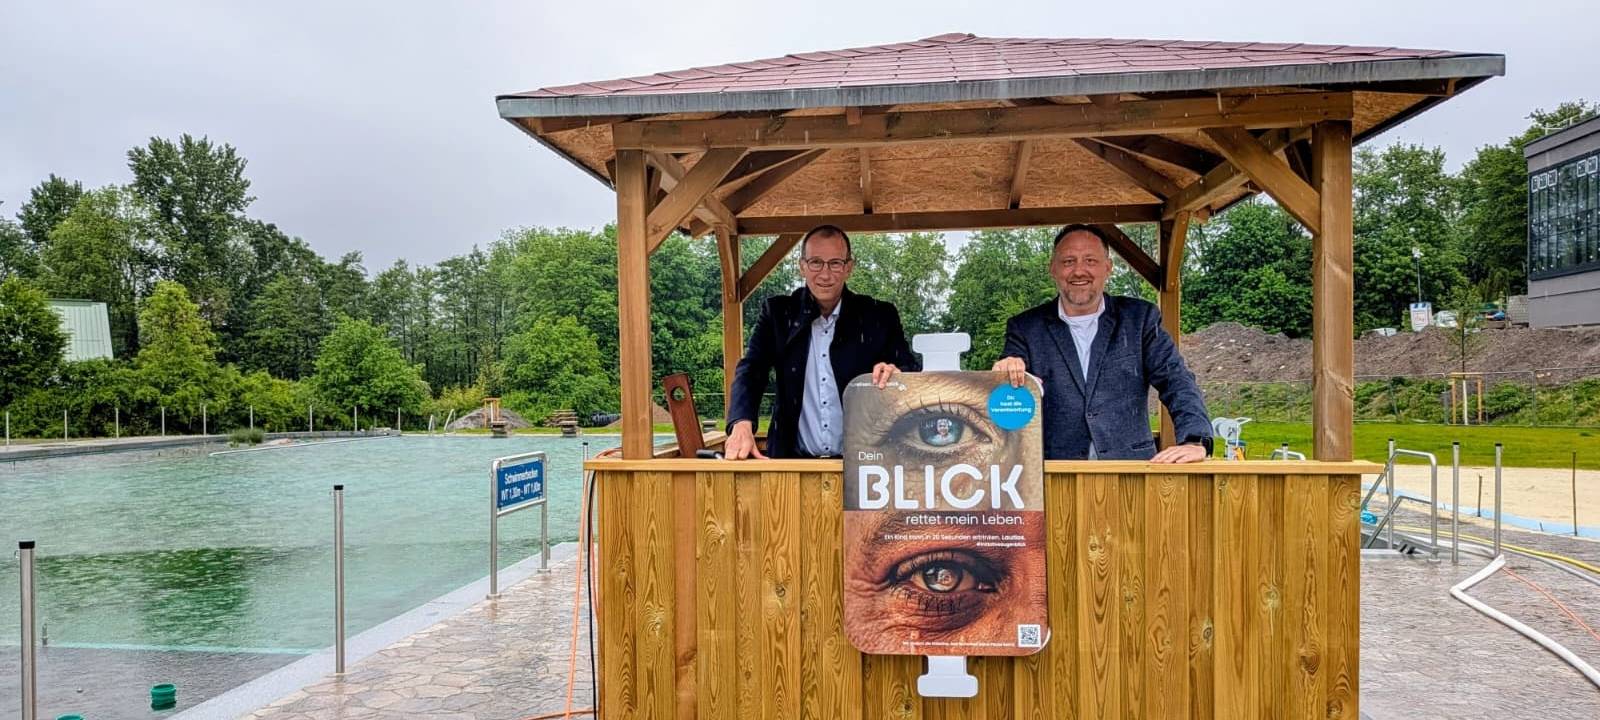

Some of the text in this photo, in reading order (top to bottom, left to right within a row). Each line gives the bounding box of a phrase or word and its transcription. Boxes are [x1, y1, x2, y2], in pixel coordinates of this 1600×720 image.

[858, 451, 884, 461] Dein
[858, 463, 1025, 510] BLICK
[905, 514, 1025, 526] rettet mein Leben.
